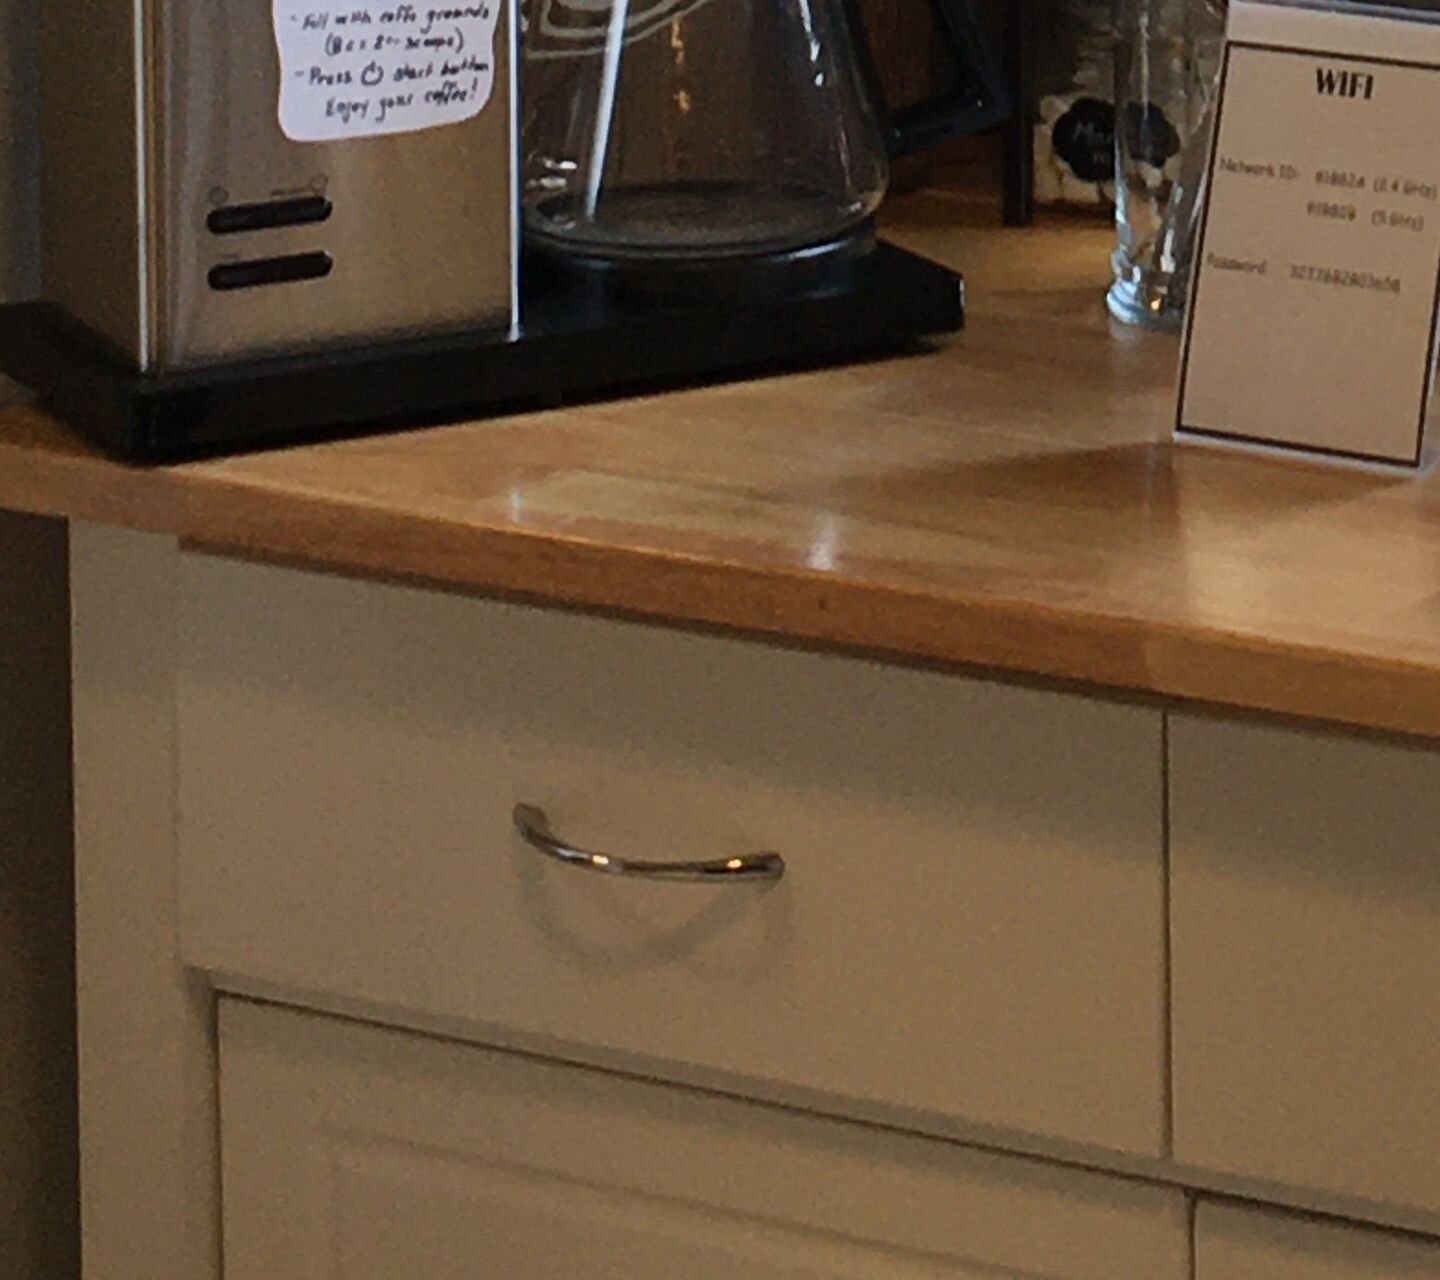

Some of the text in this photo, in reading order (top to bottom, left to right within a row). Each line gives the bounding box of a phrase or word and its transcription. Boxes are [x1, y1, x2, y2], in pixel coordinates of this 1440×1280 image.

[303, 12, 328, 30] Fill
[335, 9, 371, 25] with
[420, 1, 489, 34] grounds
[309, 55, 490, 85] Press start button
[1316, 68, 1374, 100] WIFI
[325, 97, 369, 123] Enjoy
[375, 91, 413, 122] your
